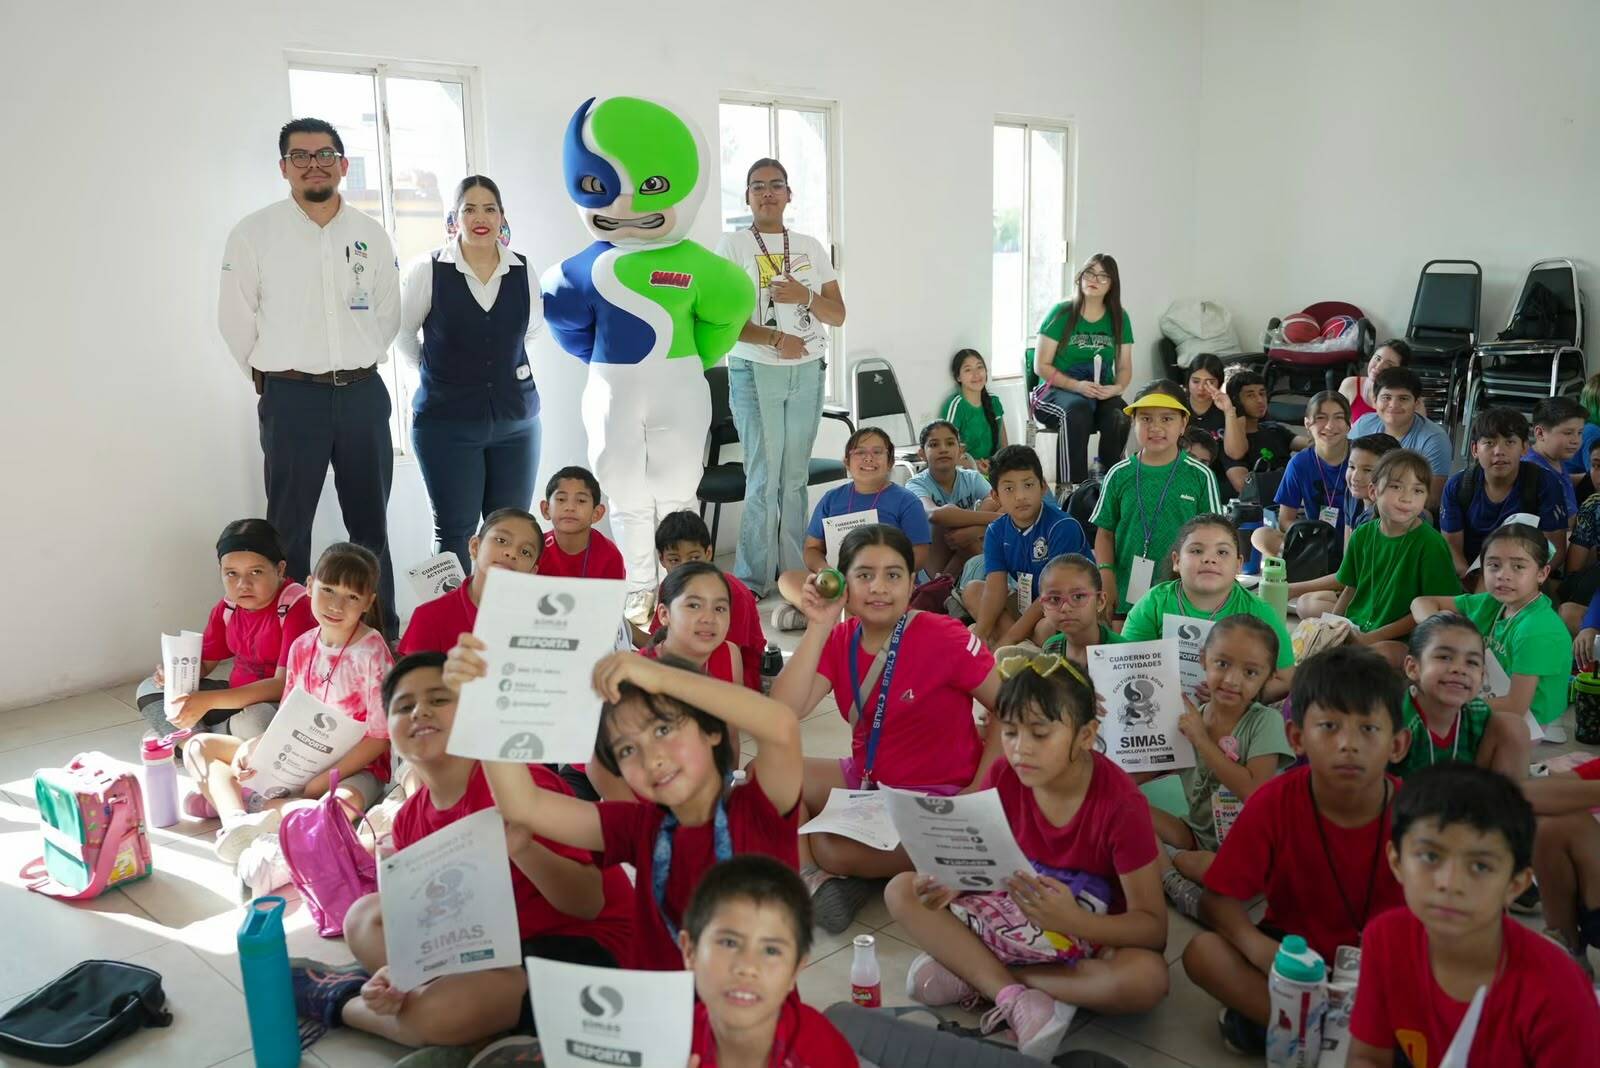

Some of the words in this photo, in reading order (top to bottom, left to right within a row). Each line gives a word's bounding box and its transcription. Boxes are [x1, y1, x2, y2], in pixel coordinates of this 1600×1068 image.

[517, 637, 570, 649] REPORTA
[1109, 653, 1151, 663] CUADERNO
[1112, 660, 1162, 670] ACTIVIDADES
[1120, 734, 1166, 748] SIMAS
[420, 924, 485, 954] SIMAS
